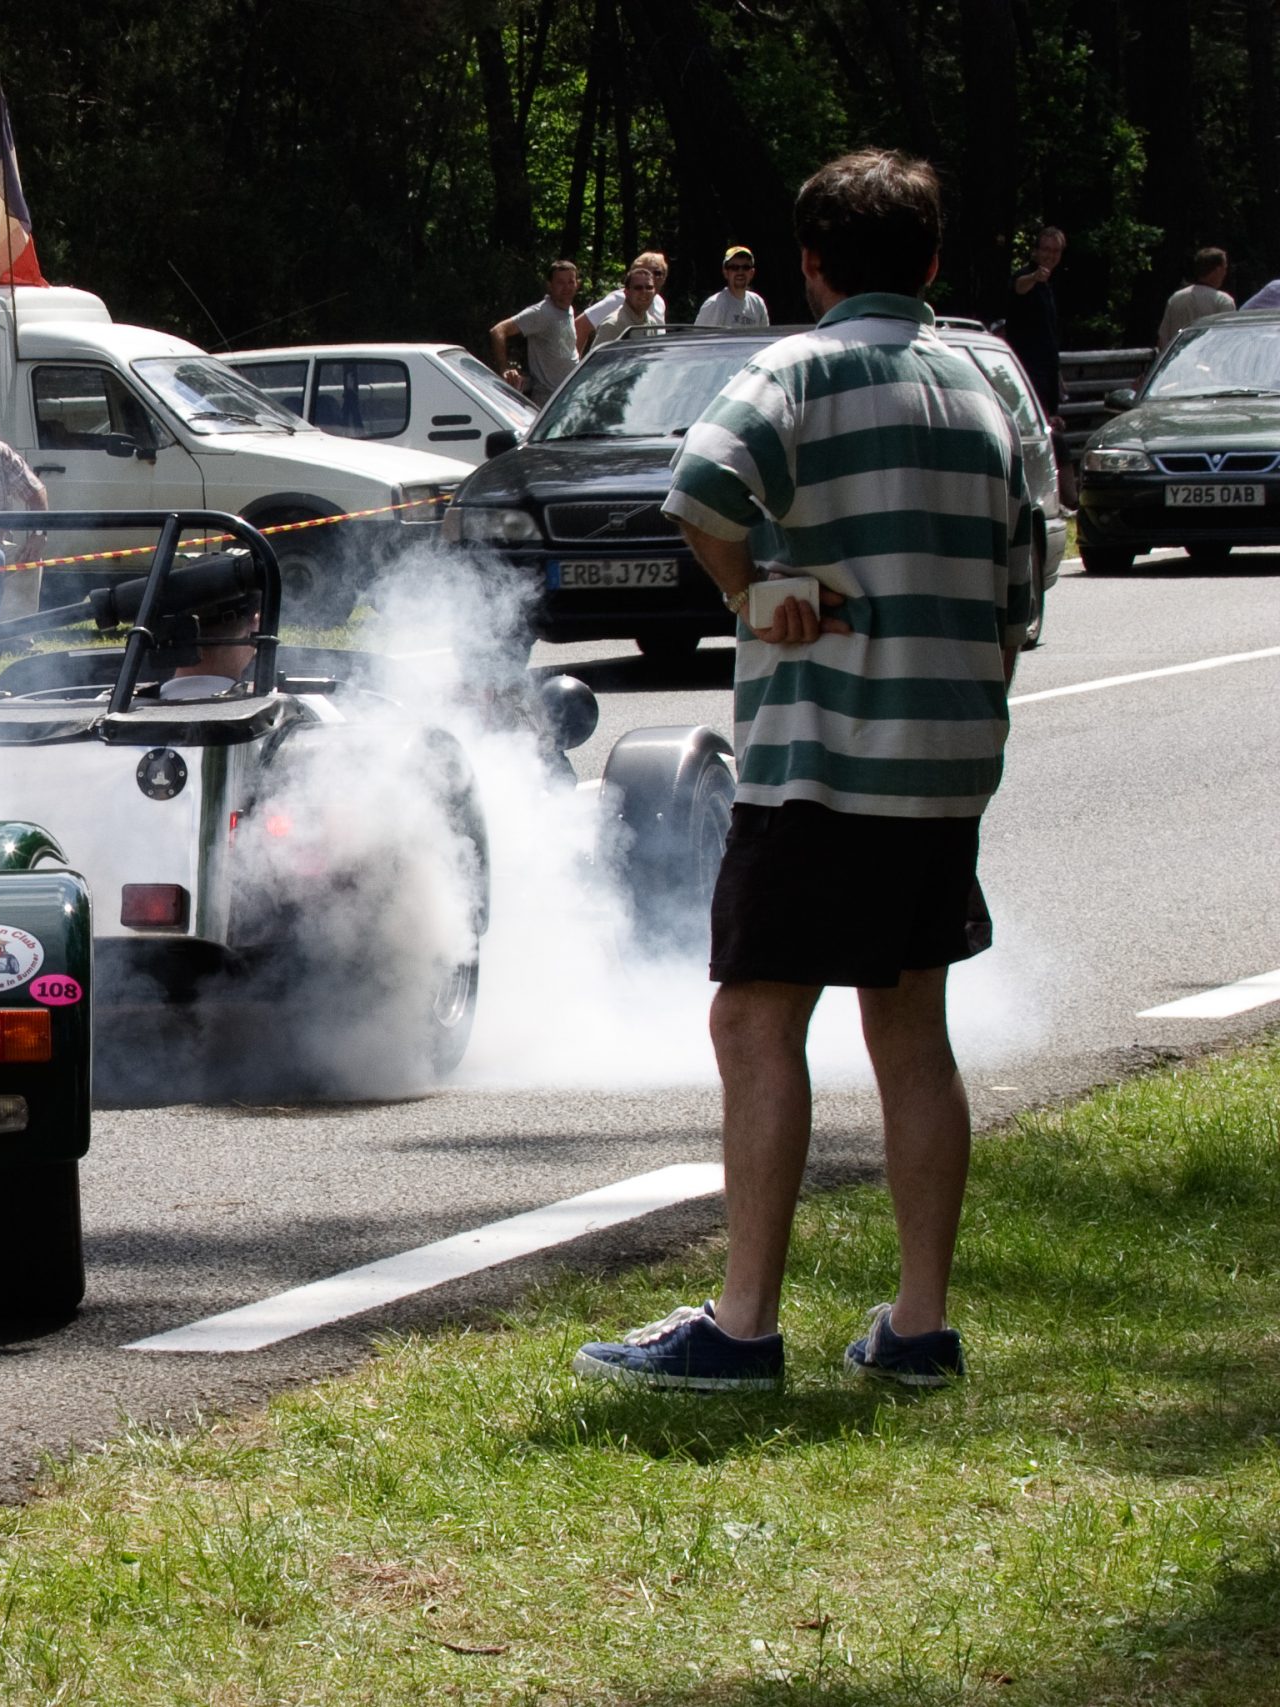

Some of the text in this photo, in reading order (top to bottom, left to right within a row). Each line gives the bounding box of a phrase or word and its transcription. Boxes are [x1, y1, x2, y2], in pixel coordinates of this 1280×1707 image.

[1170, 486, 1255, 504] Y285 OAB
[560, 563, 601, 586] ERB
[11, 931, 37, 949] Club
[6, 979, 16, 987] in
[16, 953, 40, 981] Summer
[36, 982, 78, 1000] 108
